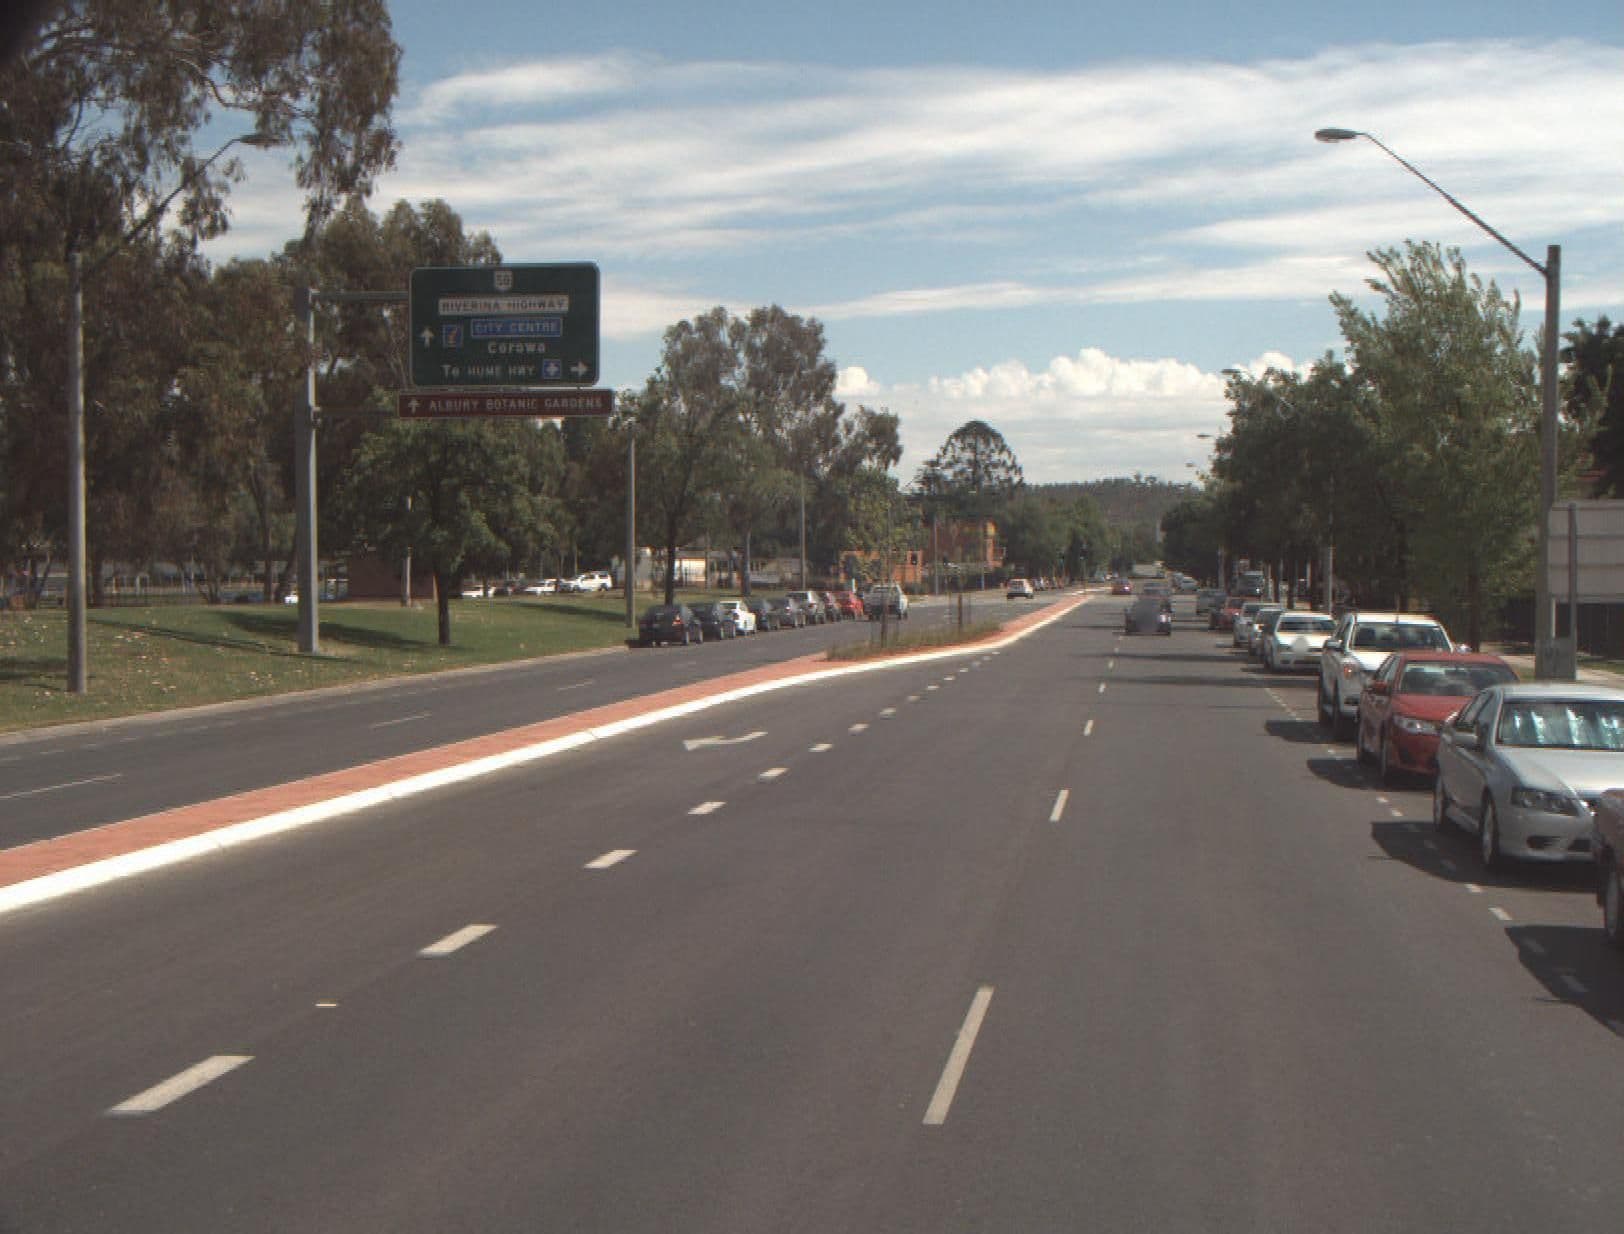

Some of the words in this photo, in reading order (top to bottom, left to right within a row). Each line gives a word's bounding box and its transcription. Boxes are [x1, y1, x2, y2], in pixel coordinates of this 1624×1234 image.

[442, 300, 500, 312] RIVERINA
[507, 299, 565, 311] HIGHWAY
[475, 321, 503, 333] CITY
[510, 321, 558, 333] CENTRE
[442, 364, 460, 376] To
[429, 399, 478, 411] ALBURY
[486, 399, 537, 410] BOTANIC
[544, 398, 603, 409] GARDENS
